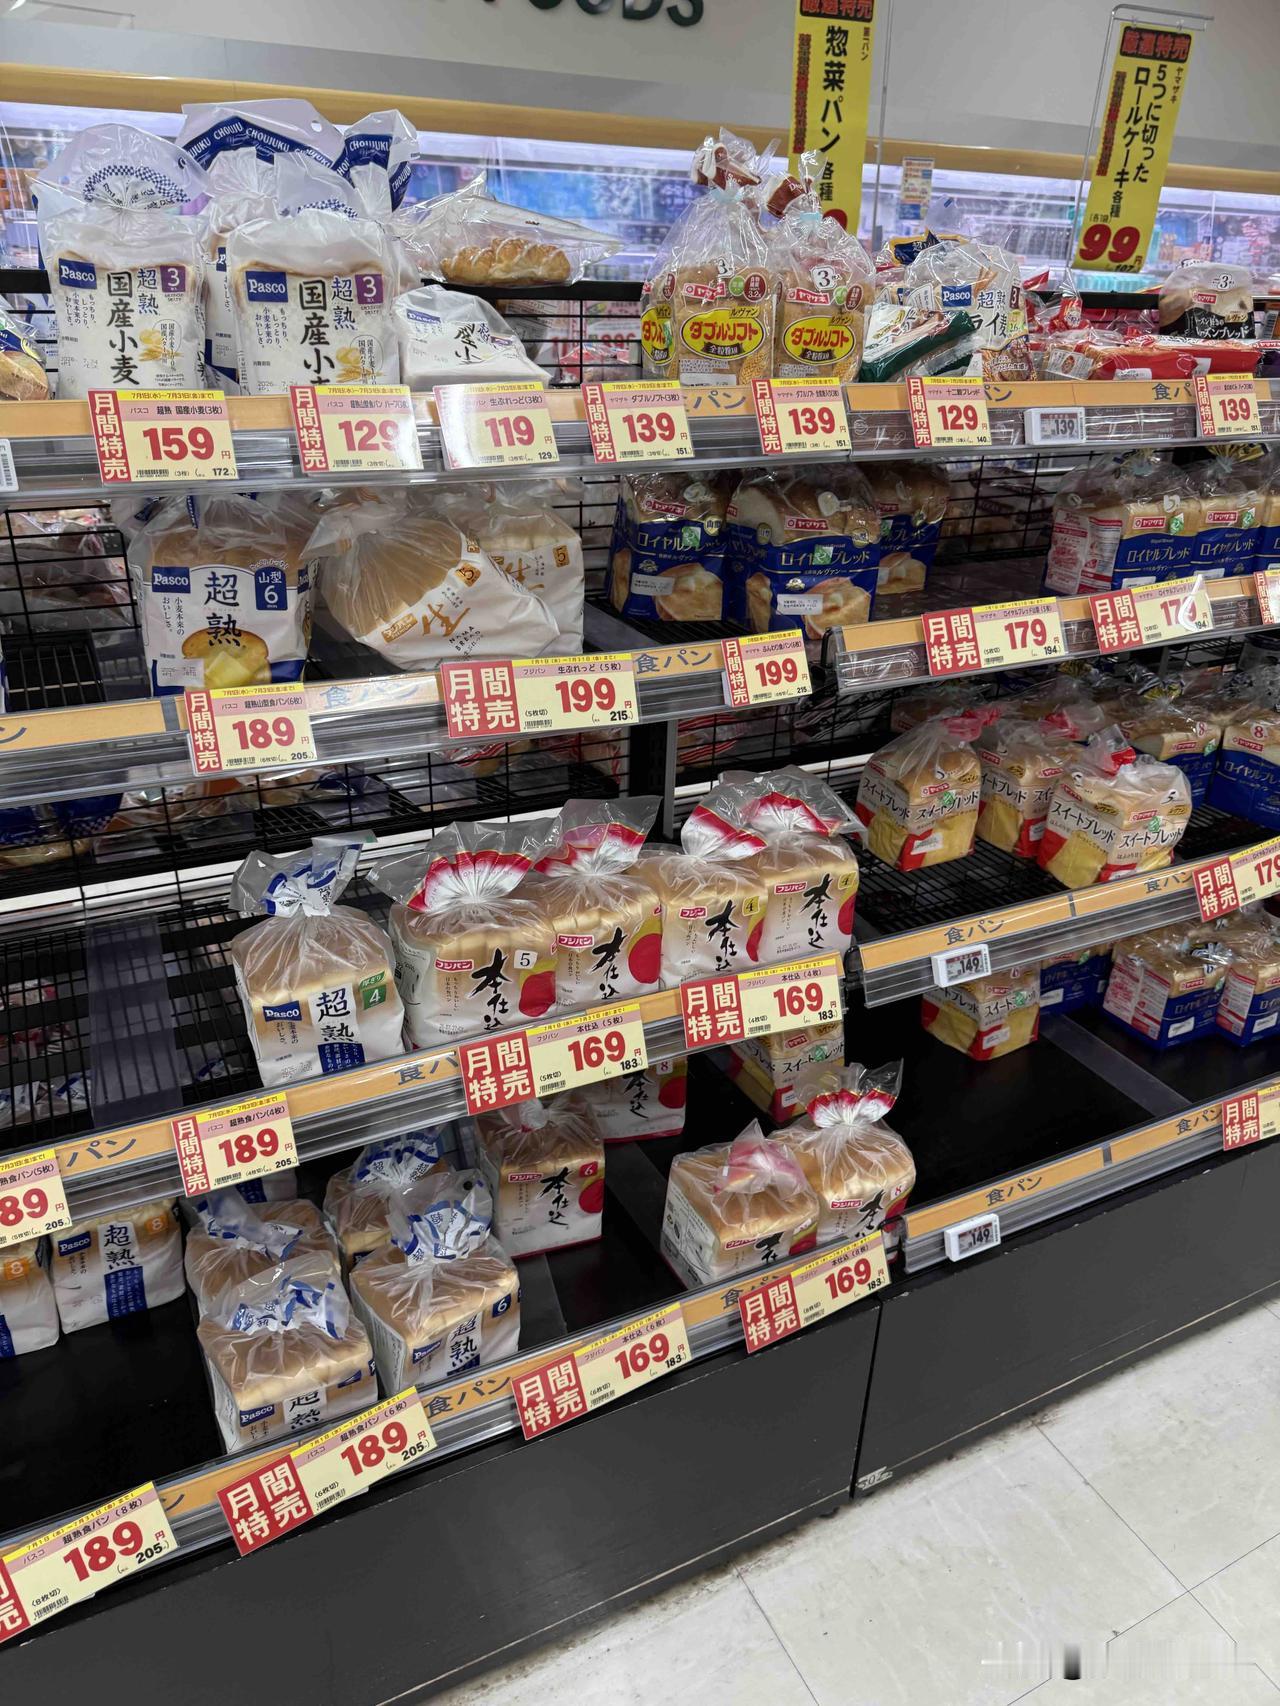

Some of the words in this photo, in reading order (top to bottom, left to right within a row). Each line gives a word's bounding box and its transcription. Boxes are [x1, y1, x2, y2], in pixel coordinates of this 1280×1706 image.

[820, 26, 849, 153] 惣菜パン
[245, 127, 290, 152] CHOUJUKU
[1113, 66, 1151, 189] ロールケーキ
[1133, 64, 1168, 184] 5つに切った
[1079, 223, 1140, 264] 99
[60, 265, 95, 282] Pasco
[167, 268, 180, 286] 3
[248, 279, 286, 294] Pasco
[362, 276, 377, 298] 3
[137, 268, 159, 316] 超熟
[331, 277, 357, 331] 超熟
[943, 291, 971, 301] Pasco
[107, 271, 140, 385] 国産小麦
[689, 321, 759, 341] ダブルソフト
[791, 327, 849, 348] ダブルソフト
[683, 389, 747, 412] パン
[1151, 381, 1193, 401] 食パ
[1196, 376, 1215, 435] 月間特売
[586, 386, 616, 461] 月間特売
[753, 381, 781, 452] 月間特売
[788, 406, 836, 436] 139
[910, 379, 931, 444] 月間特売
[937, 404, 979, 431] 129
[1219, 397, 1252, 422] 139
[94, 393, 129, 480] 月間特売
[295, 388, 328, 470] 月間特売
[338, 419, 400, 452] 129
[484, 415, 535, 448] 119
[544, 435, 552, 444] 円
[622, 411, 676, 443] 139
[835, 439, 846, 447] 151
[976, 435, 987, 443] 140
[1054, 419, 1075, 436] 139
[142, 426, 215, 461] 159
[221, 450, 231, 460] 円
[538, 451, 553, 460] 129
[676, 446, 688, 456] 151
[212, 468, 229, 477] 172
[1126, 547, 1192, 563] ロイヤルブレッド
[152, 571, 189, 587] Pasco
[258, 571, 283, 584] 山型
[203, 571, 243, 648] 超熟
[264, 585, 279, 604] 6
[1095, 594, 1135, 624] 月間
[174, 596, 185, 636] 小麦本来の
[928, 614, 974, 644] 月間
[1004, 618, 1048, 651] 179
[1043, 645, 1058, 655] 194
[1100, 620, 1141, 649] 特売
[523, 668, 546, 676] フジパン
[634, 649, 713, 675] 食パン
[755, 657, 798, 688] 199
[931, 642, 979, 671] 特売
[449, 666, 511, 701] 月間
[724, 641, 749, 705] 月間特売
[555, 678, 616, 714] 199
[796, 686, 808, 694] 215
[190, 693, 221, 770] 月間特売
[450, 699, 516, 732] 特売
[609, 709, 628, 722] 215
[232, 716, 296, 751] 189
[1254, 725, 1264, 739] 8
[290, 752, 308, 761] 205
[1051, 800, 1117, 844] スイートブレッド
[1119, 826, 1185, 850] スイートブレッド
[775, 883, 807, 893] フジパン
[1197, 863, 1233, 895] 月間
[799, 872, 834, 950] 本仕込
[1201, 885, 1237, 917] 特売
[559, 936, 593, 946] フジパン
[704, 899, 740, 973] 本仕込
[944, 919, 1006, 946] 食パン
[435, 960, 474, 971] フジパン
[591, 927, 628, 1000] 本仕込
[959, 956, 980, 975] 149
[368, 988, 381, 1003] 4
[467, 948, 512, 1031] 本仕込
[685, 980, 739, 1016] 月間
[772, 982, 824, 1018] 169
[264, 1008, 301, 1019] Pasco
[315, 987, 355, 1043] 超熟
[687, 1010, 742, 1043] 特売
[817, 1009, 834, 1021] 183
[466, 1039, 527, 1079] 月間
[567, 1029, 627, 1073] 169
[619, 1057, 638, 1072] 183
[468, 1070, 532, 1109] 特売
[1226, 1096, 1258, 1125] 月間
[218, 1127, 280, 1168] 189
[1225, 1119, 1259, 1146] 特売
[176, 1119, 210, 1195] 月間特売
[275, 1156, 293, 1170] 205
[0, 1187, 49, 1227] 89
[538, 1165, 575, 1227] 本仕込
[985, 1176, 1043, 1207] 食パン
[45, 1218, 64, 1231] 205
[971, 1228, 991, 1247] 149
[103, 1224, 136, 1271] 超熟
[824, 1257, 872, 1300] 169
[866, 1277, 883, 1292] 183
[744, 1280, 793, 1325] 月間
[748, 1307, 799, 1347] 特売
[614, 1332, 671, 1382] 169
[664, 1353, 683, 1370] 183
[423, 1375, 513, 1419] 食パン
[520, 1359, 577, 1408] 月間
[523, 1390, 584, 1433] 特売
[340, 1421, 409, 1477] 189
[400, 1440, 425, 1463] 205
[226, 1461, 298, 1520] 月間
[234, 1495, 309, 1546] 特売
[62, 1520, 144, 1583] 189
[134, 1542, 163, 1565] 205
